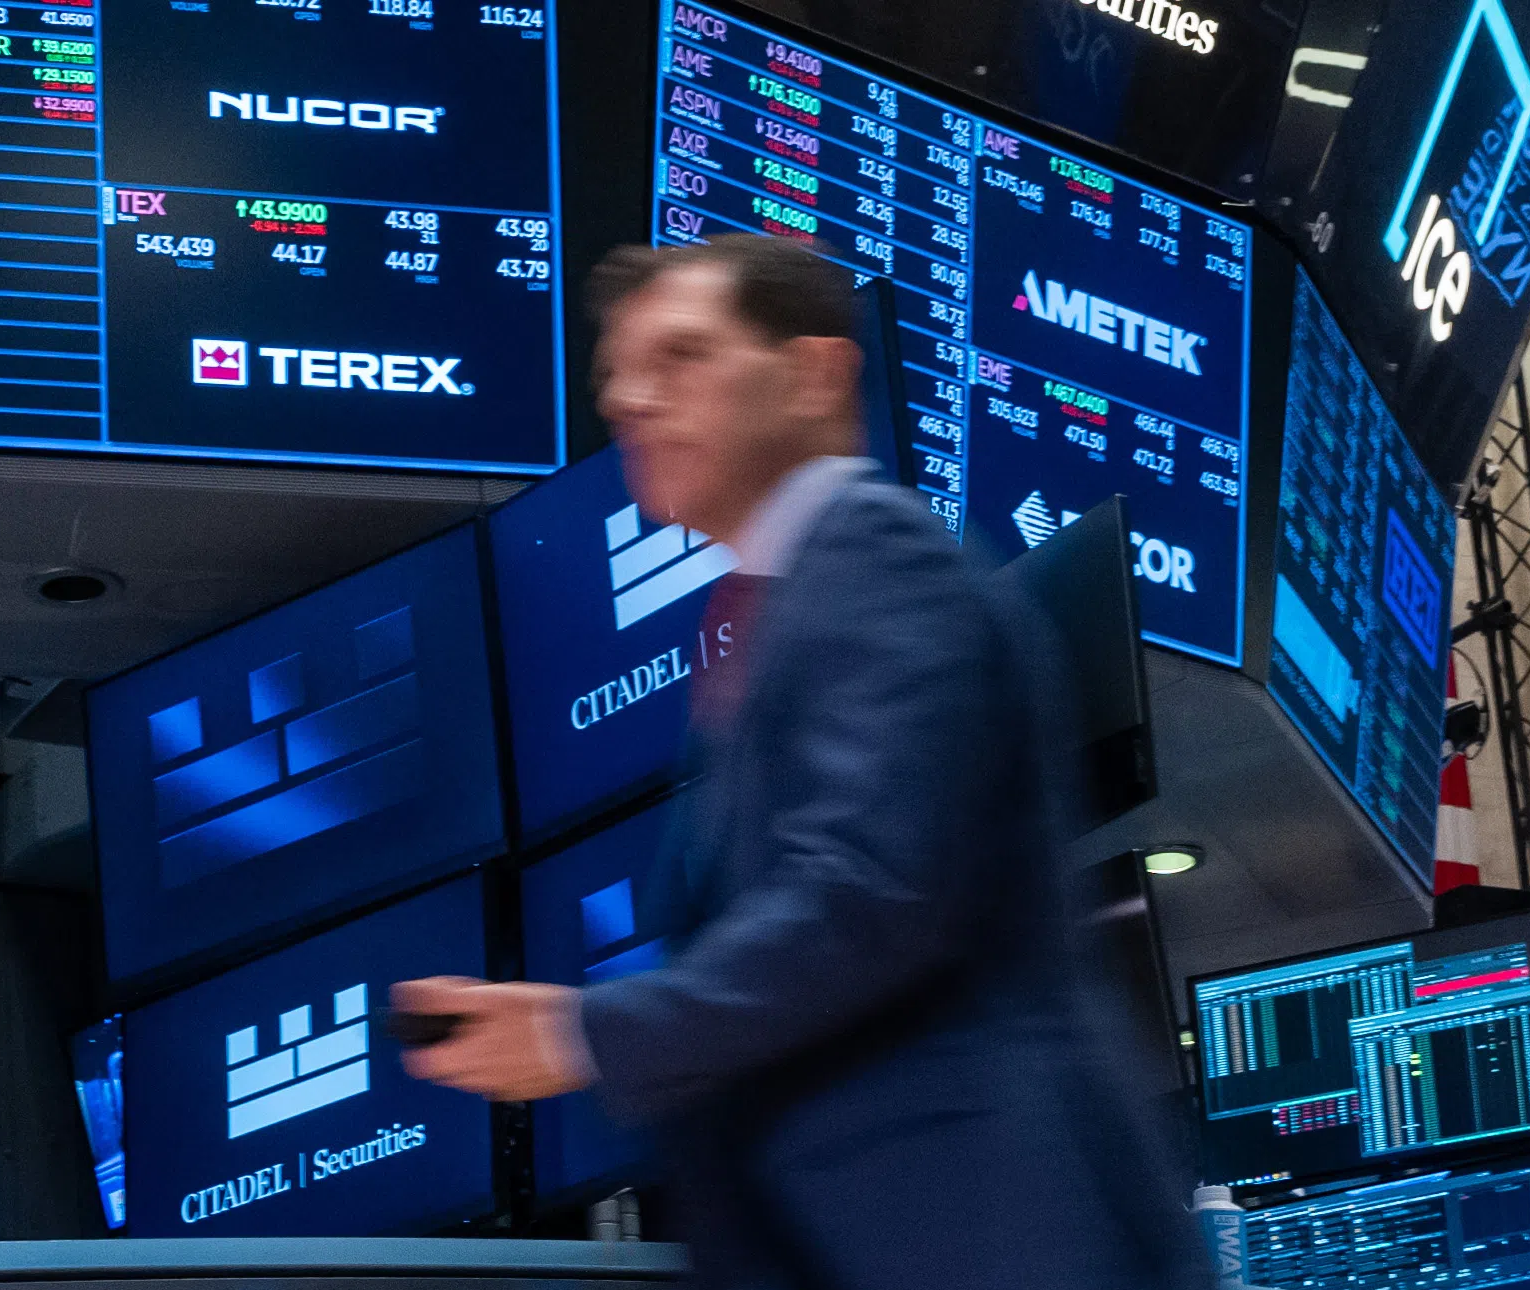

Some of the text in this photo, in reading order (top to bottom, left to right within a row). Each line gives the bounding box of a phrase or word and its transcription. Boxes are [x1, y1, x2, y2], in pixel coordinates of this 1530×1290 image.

[369, 0, 434, 19] 118.84
[480, 6, 543, 27] 116.24
[673, 46, 713, 77] AME
[674, 6, 728, 42] AMCR
[868, 83, 898, 107] 9.41
[209, 91, 437, 134] NUCOR
[671, 86, 720, 120] ASPN
[670, 127, 709, 157] AXR
[985, 130, 1020, 159] AME
[669, 166, 707, 196] BCO
[116, 190, 548, 239] TEX 43.9900 43.98 43.99
[667, 207, 704, 234] CSV
[136, 233, 549, 279] 543,439 44.17 44.87 43.79
[259, 347, 461, 395] TEREX
[978, 356, 1013, 385] EME
[931, 497, 960, 520] 5.15
[946, 519, 957, 531] 32
[571, 647, 691, 730] CITADEL
[180, 1123, 427, 1224] CITADEL Securities
